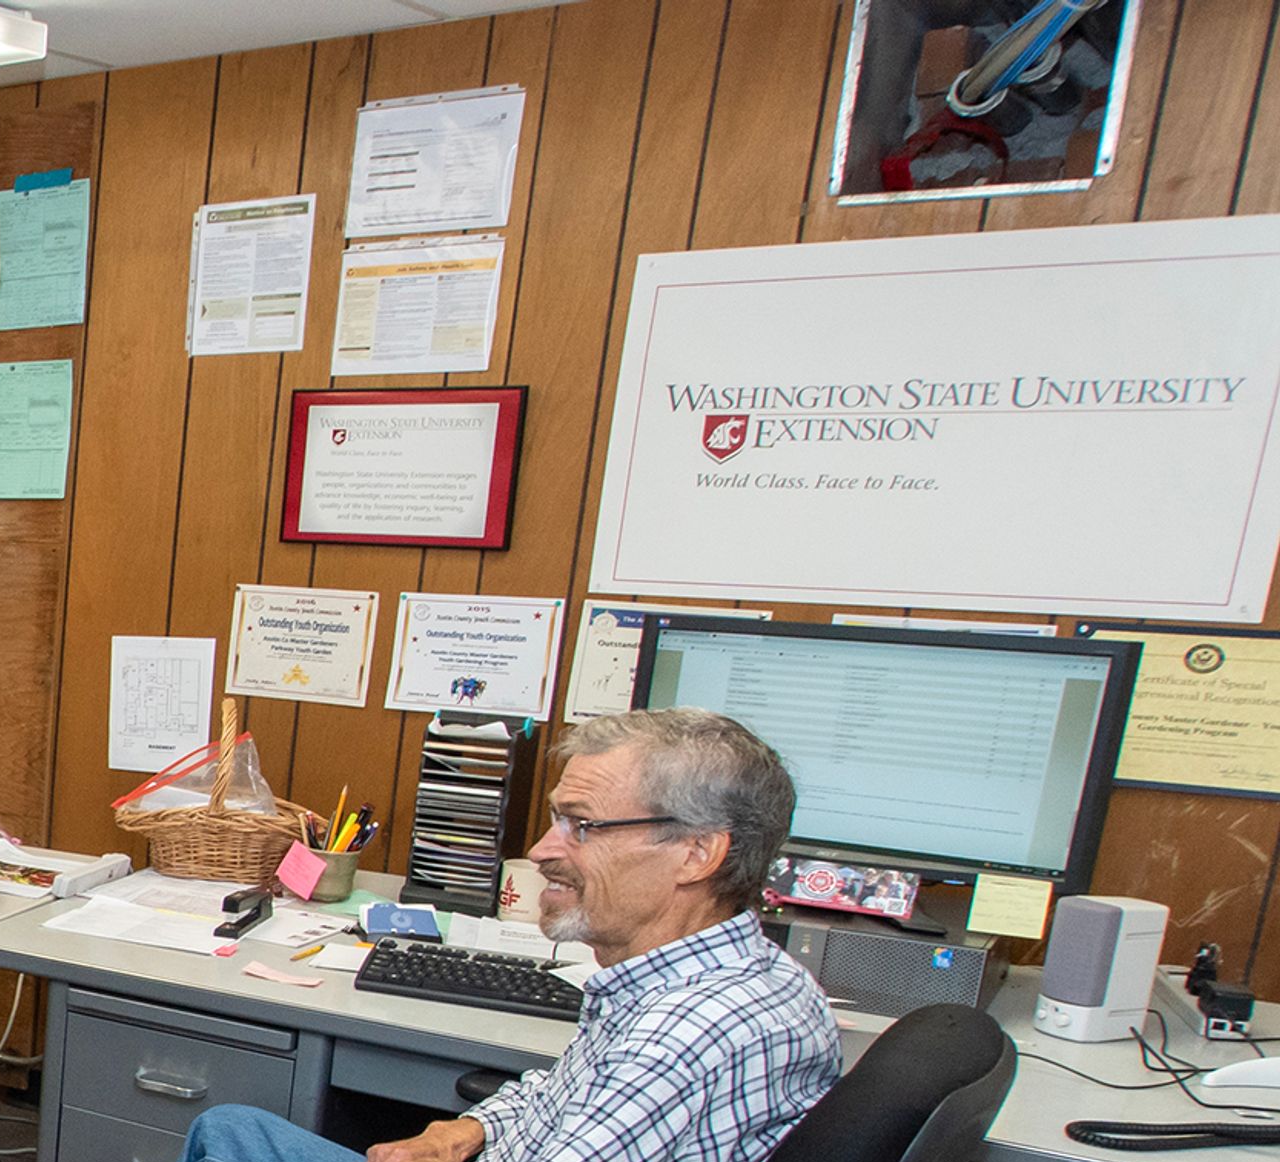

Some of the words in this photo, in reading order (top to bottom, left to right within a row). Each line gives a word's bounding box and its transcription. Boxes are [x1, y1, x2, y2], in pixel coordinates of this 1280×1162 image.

[666, 383, 893, 413] WASHINGTON
[899, 378, 1000, 410] STATE
[1011, 376, 1246, 409] UNIVERSITY
[320, 417, 388, 429] WASHINGTON
[390, 417, 417, 428] STATE
[421, 417, 484, 429] UNIVERSITY
[348, 430, 403, 442] EXTENSION
[751, 417, 940, 449] EXTENSION
[316, 470, 354, 480] Washington
[696, 473, 751, 489] World
[754, 473, 810, 490] Class.
[814, 474, 859, 490] Face
[863, 475, 884, 490] to
[888, 475, 941, 492] Face.
[259, 616, 294, 632] Outstanding
[294, 620, 312, 630] Youth
[312, 620, 350, 635] Organization
[426, 630, 465, 641] Outstanding
[465, 632, 484, 640] Youth
[485, 633, 527, 643] Organization
[1221, 679, 1267, 690] Special
[1163, 715, 1198, 724] Master
[1200, 717, 1249, 728] Gardener
[1137, 723, 1191, 735] Gardening
[1193, 728, 1239, 737] Program
